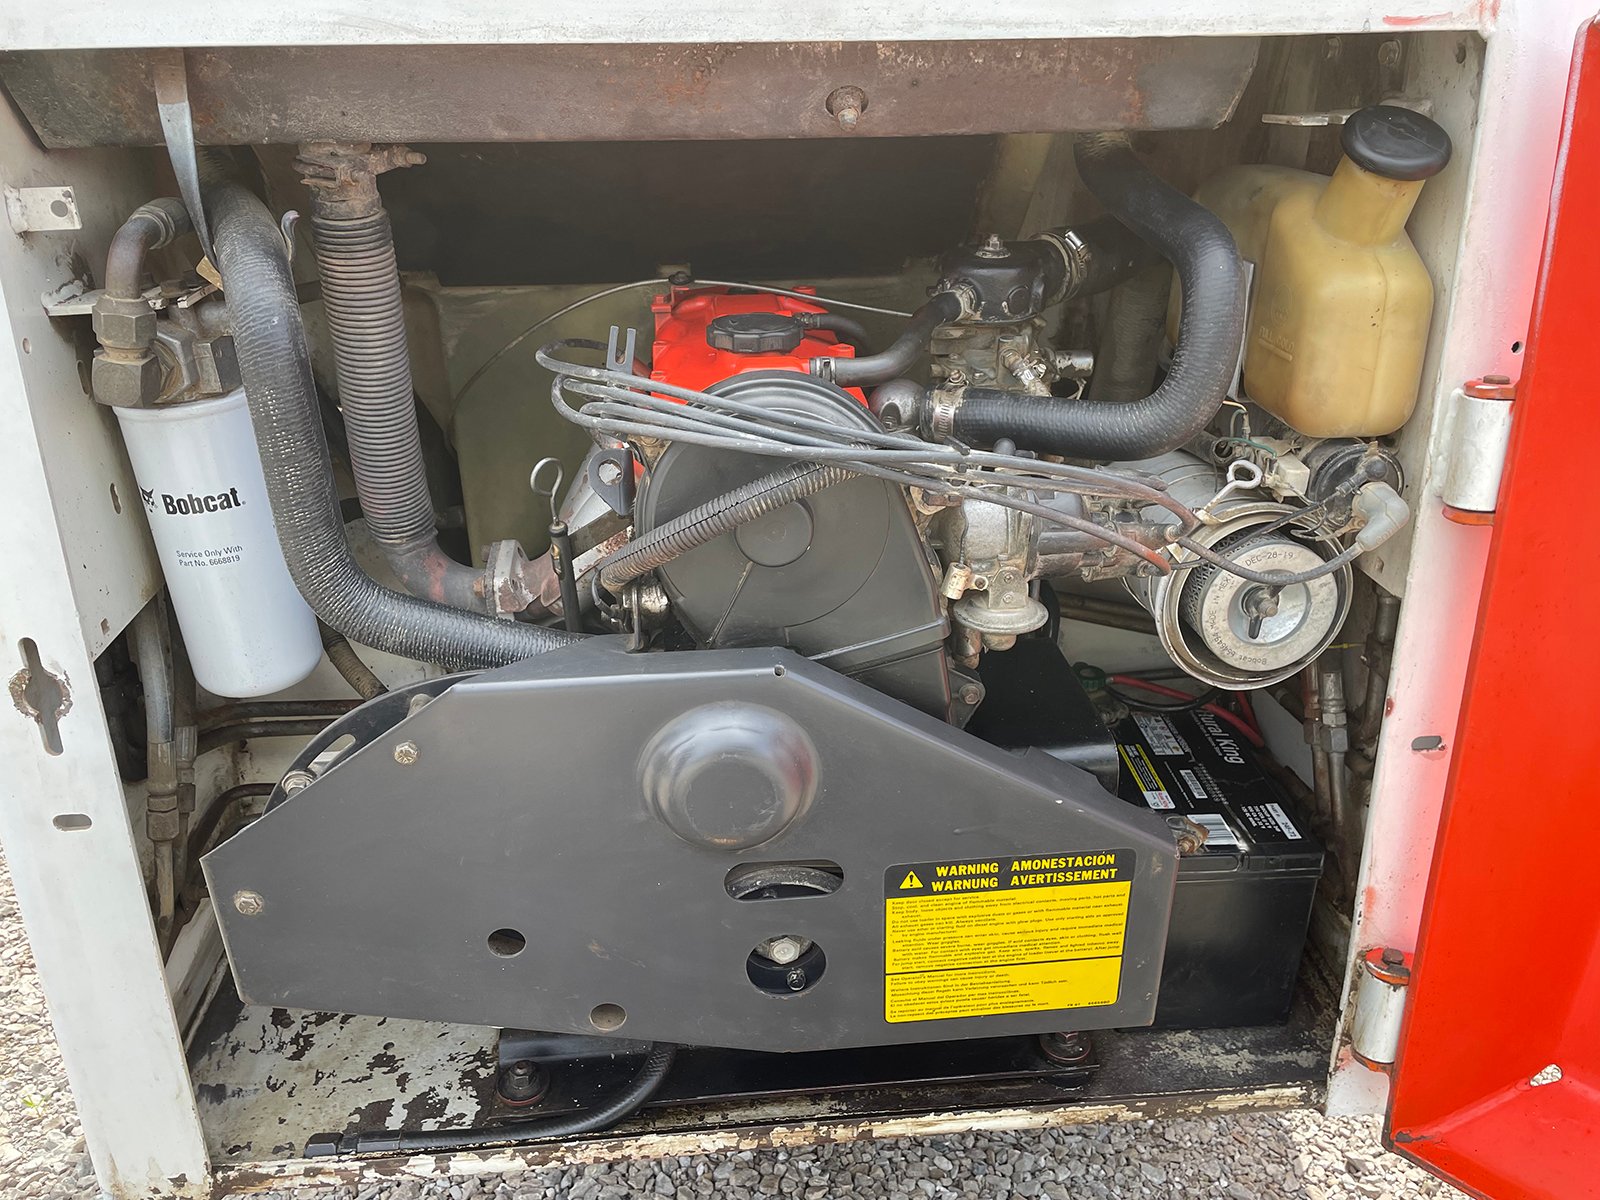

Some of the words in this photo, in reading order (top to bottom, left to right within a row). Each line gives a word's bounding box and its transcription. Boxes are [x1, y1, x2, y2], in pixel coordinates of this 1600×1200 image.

[176, 550, 202, 558] Service
[204, 548, 222, 558] Only
[224, 546, 242, 555] With
[178, 559, 193, 567] Part
[209, 556, 241, 566] 6668819
[1208, 610, 1217, 630] MADE
[1216, 739, 1245, 764] King
[936, 862, 999, 878] WARNING
[932, 877, 999, 892] WARNUNG
[1011, 868, 1118, 886] AVERTISSEMENT
